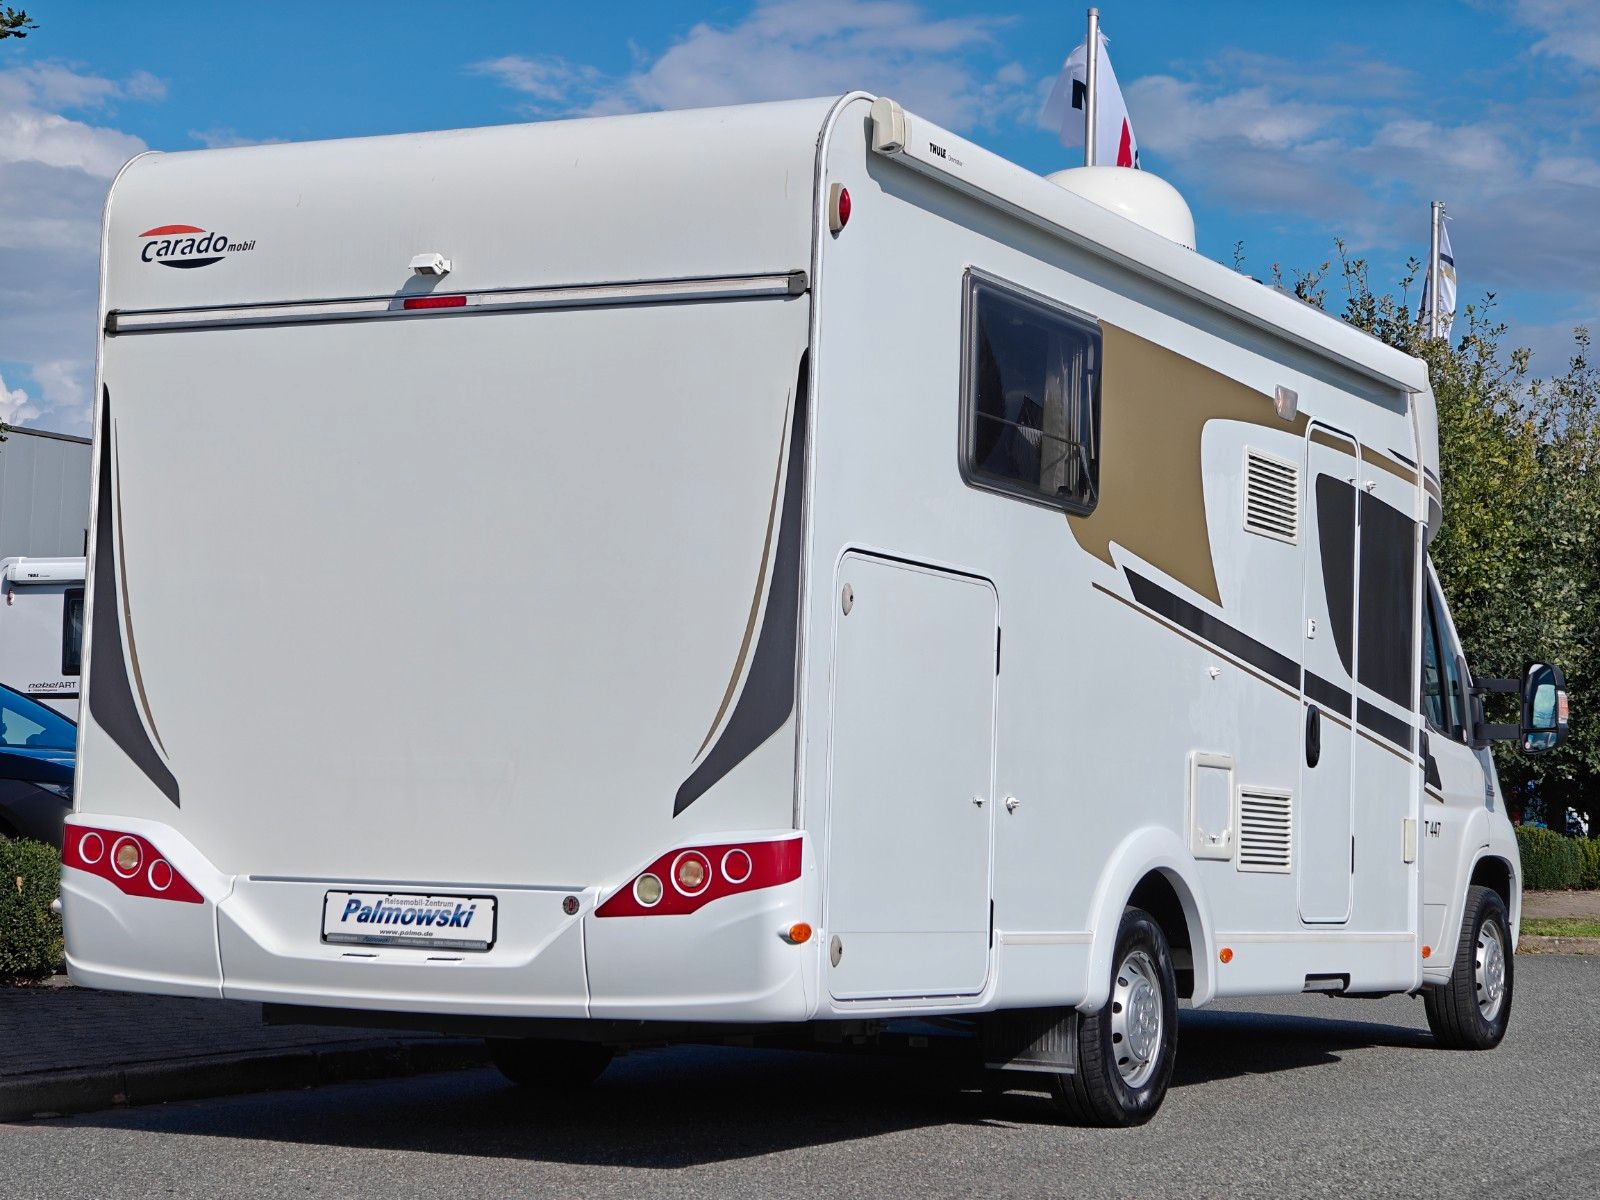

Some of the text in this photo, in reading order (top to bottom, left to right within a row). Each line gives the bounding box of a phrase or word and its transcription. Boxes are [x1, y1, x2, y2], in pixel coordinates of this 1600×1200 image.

[929, 142, 946, 158] THULE
[227, 240, 256, 252] mobil
[1424, 820, 1429, 838] T
[384, 897, 454, 907] Reisemobil-Zentrum
[341, 899, 477, 928] Palmowski
[379, 929, 433, 937] www.palmo.de
